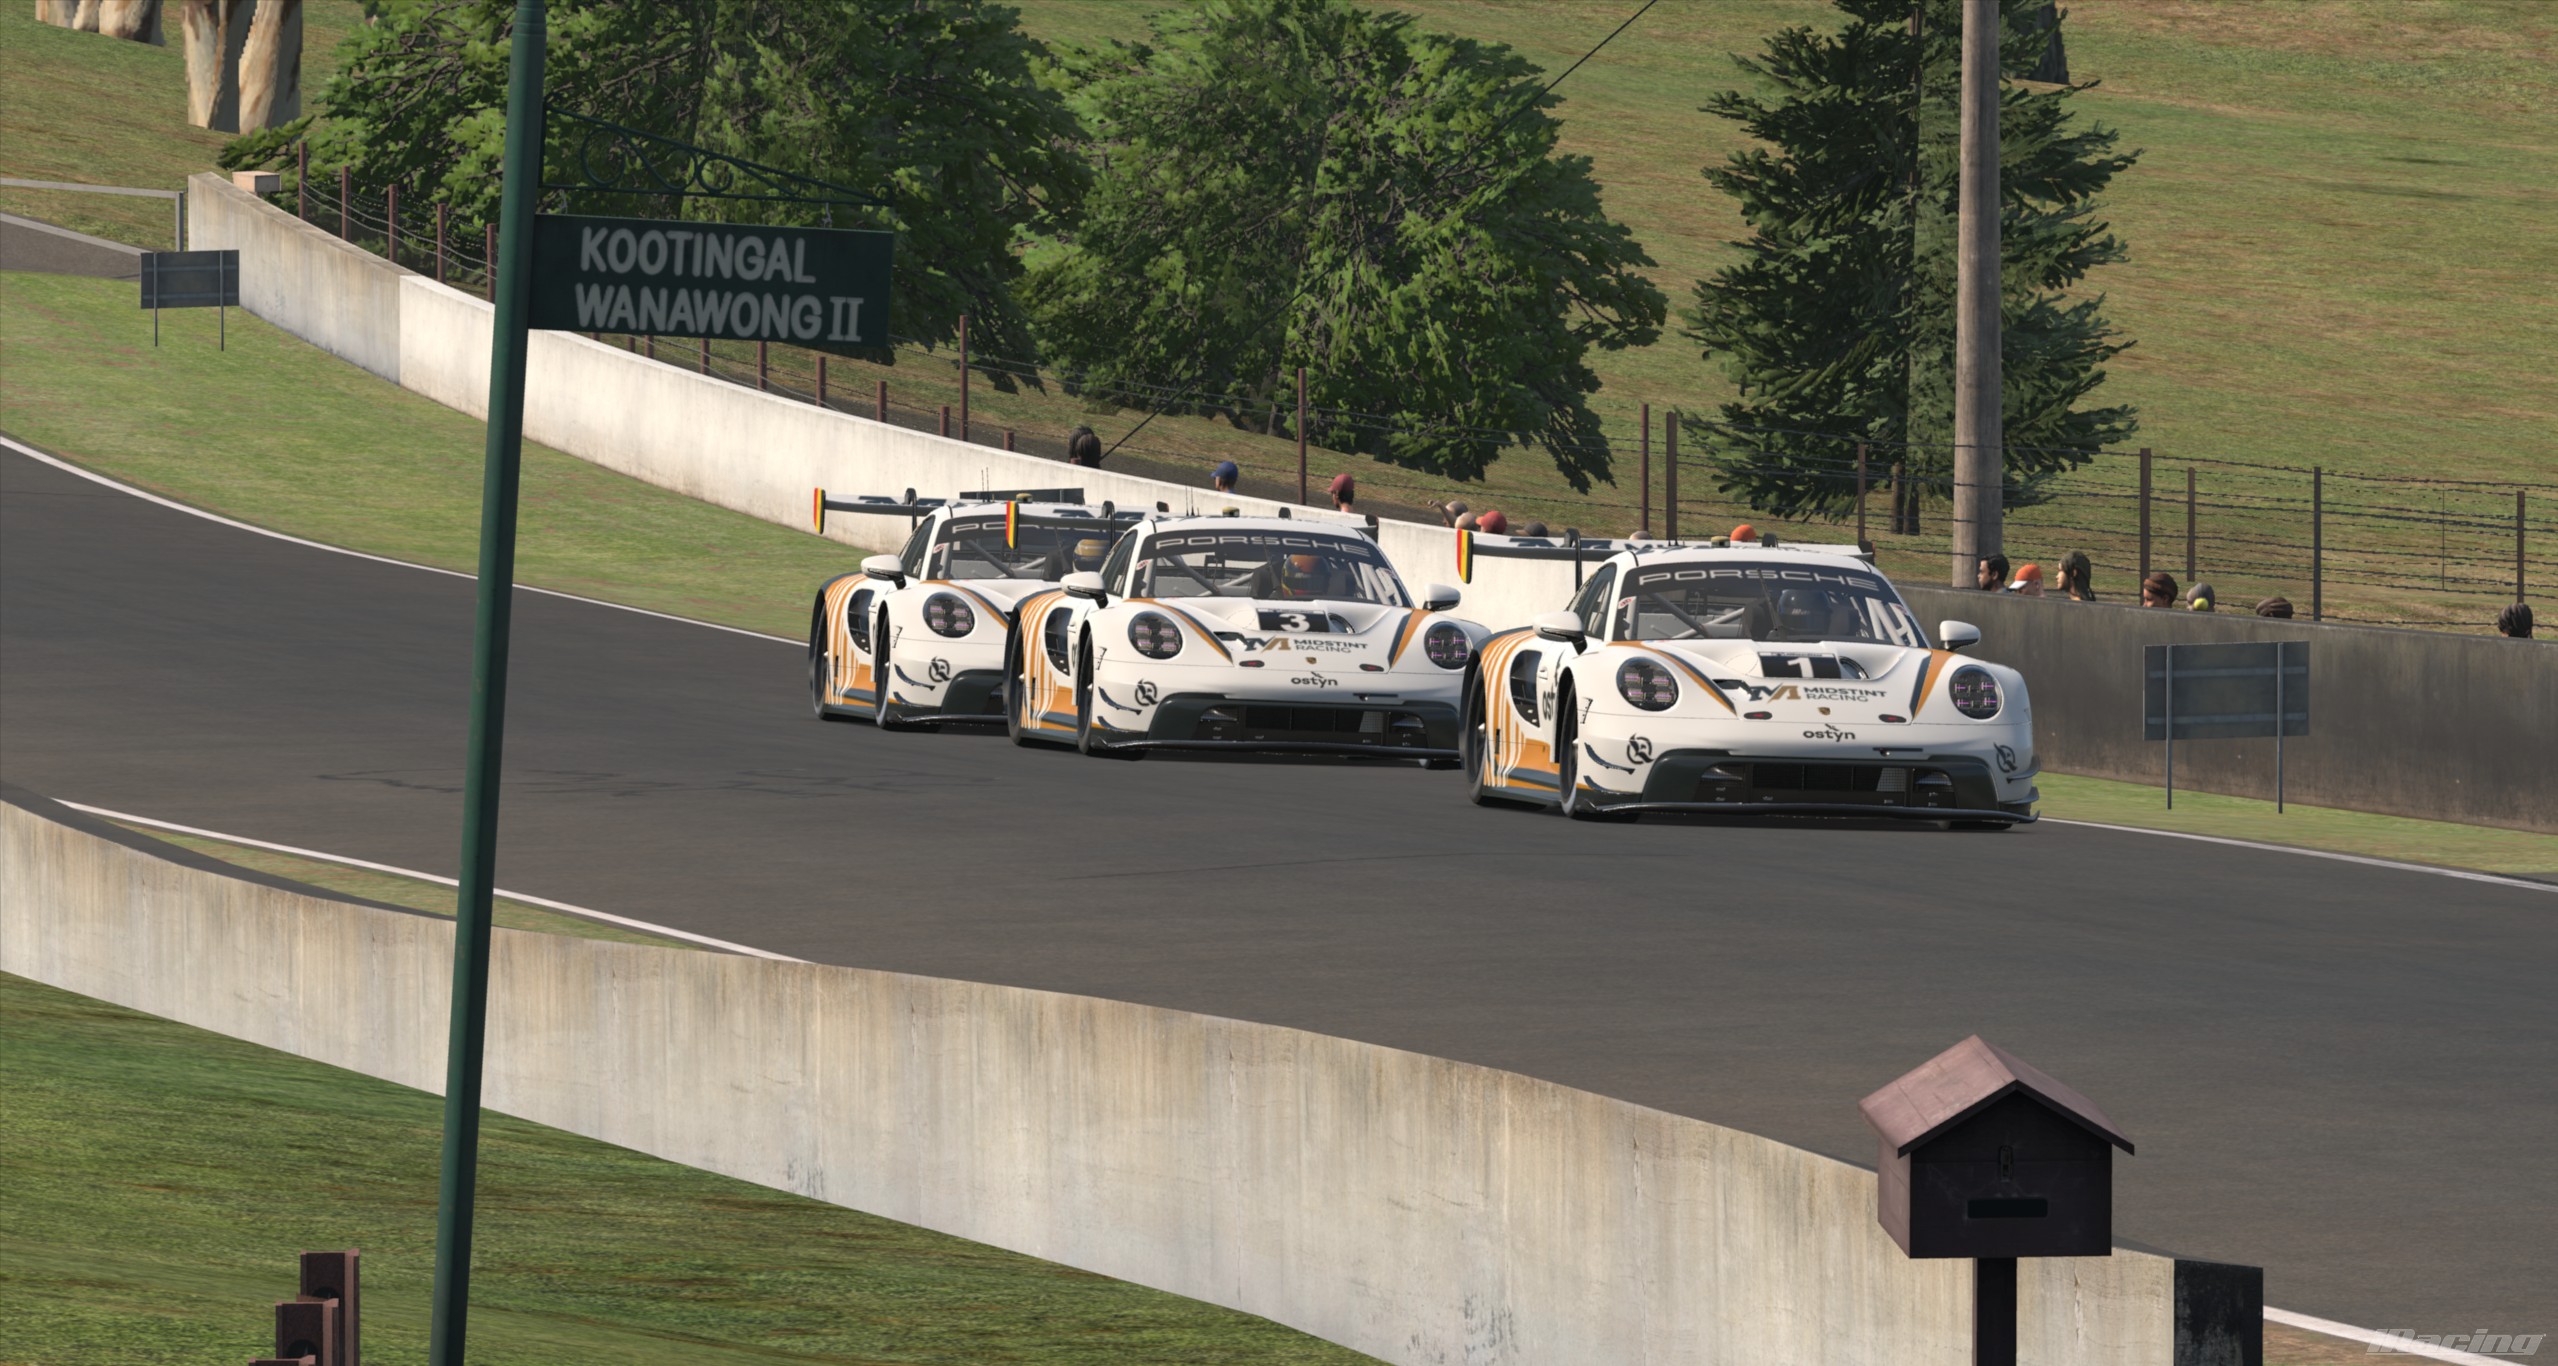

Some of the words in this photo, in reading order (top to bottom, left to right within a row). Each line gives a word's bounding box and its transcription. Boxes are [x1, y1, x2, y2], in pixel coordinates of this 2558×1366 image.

[580, 226, 816, 284] KOOTINGAL
[575, 282, 822, 339] WANAWONG
[827, 296, 864, 342] II
[1156, 536, 1370, 557] PORSCHE
[1638, 569, 1880, 591] PORSCHE
[1279, 613, 1311, 632] 3
[1293, 639, 1368, 650] MIDSTINT
[1295, 645, 1352, 654] RACING
[1787, 657, 1815, 678] 1
[1291, 675, 1339, 688] ostyn
[1803, 686, 1887, 698] MIDSTINT
[1806, 693, 1869, 702] RACING
[1802, 728, 1856, 743] ostyn
